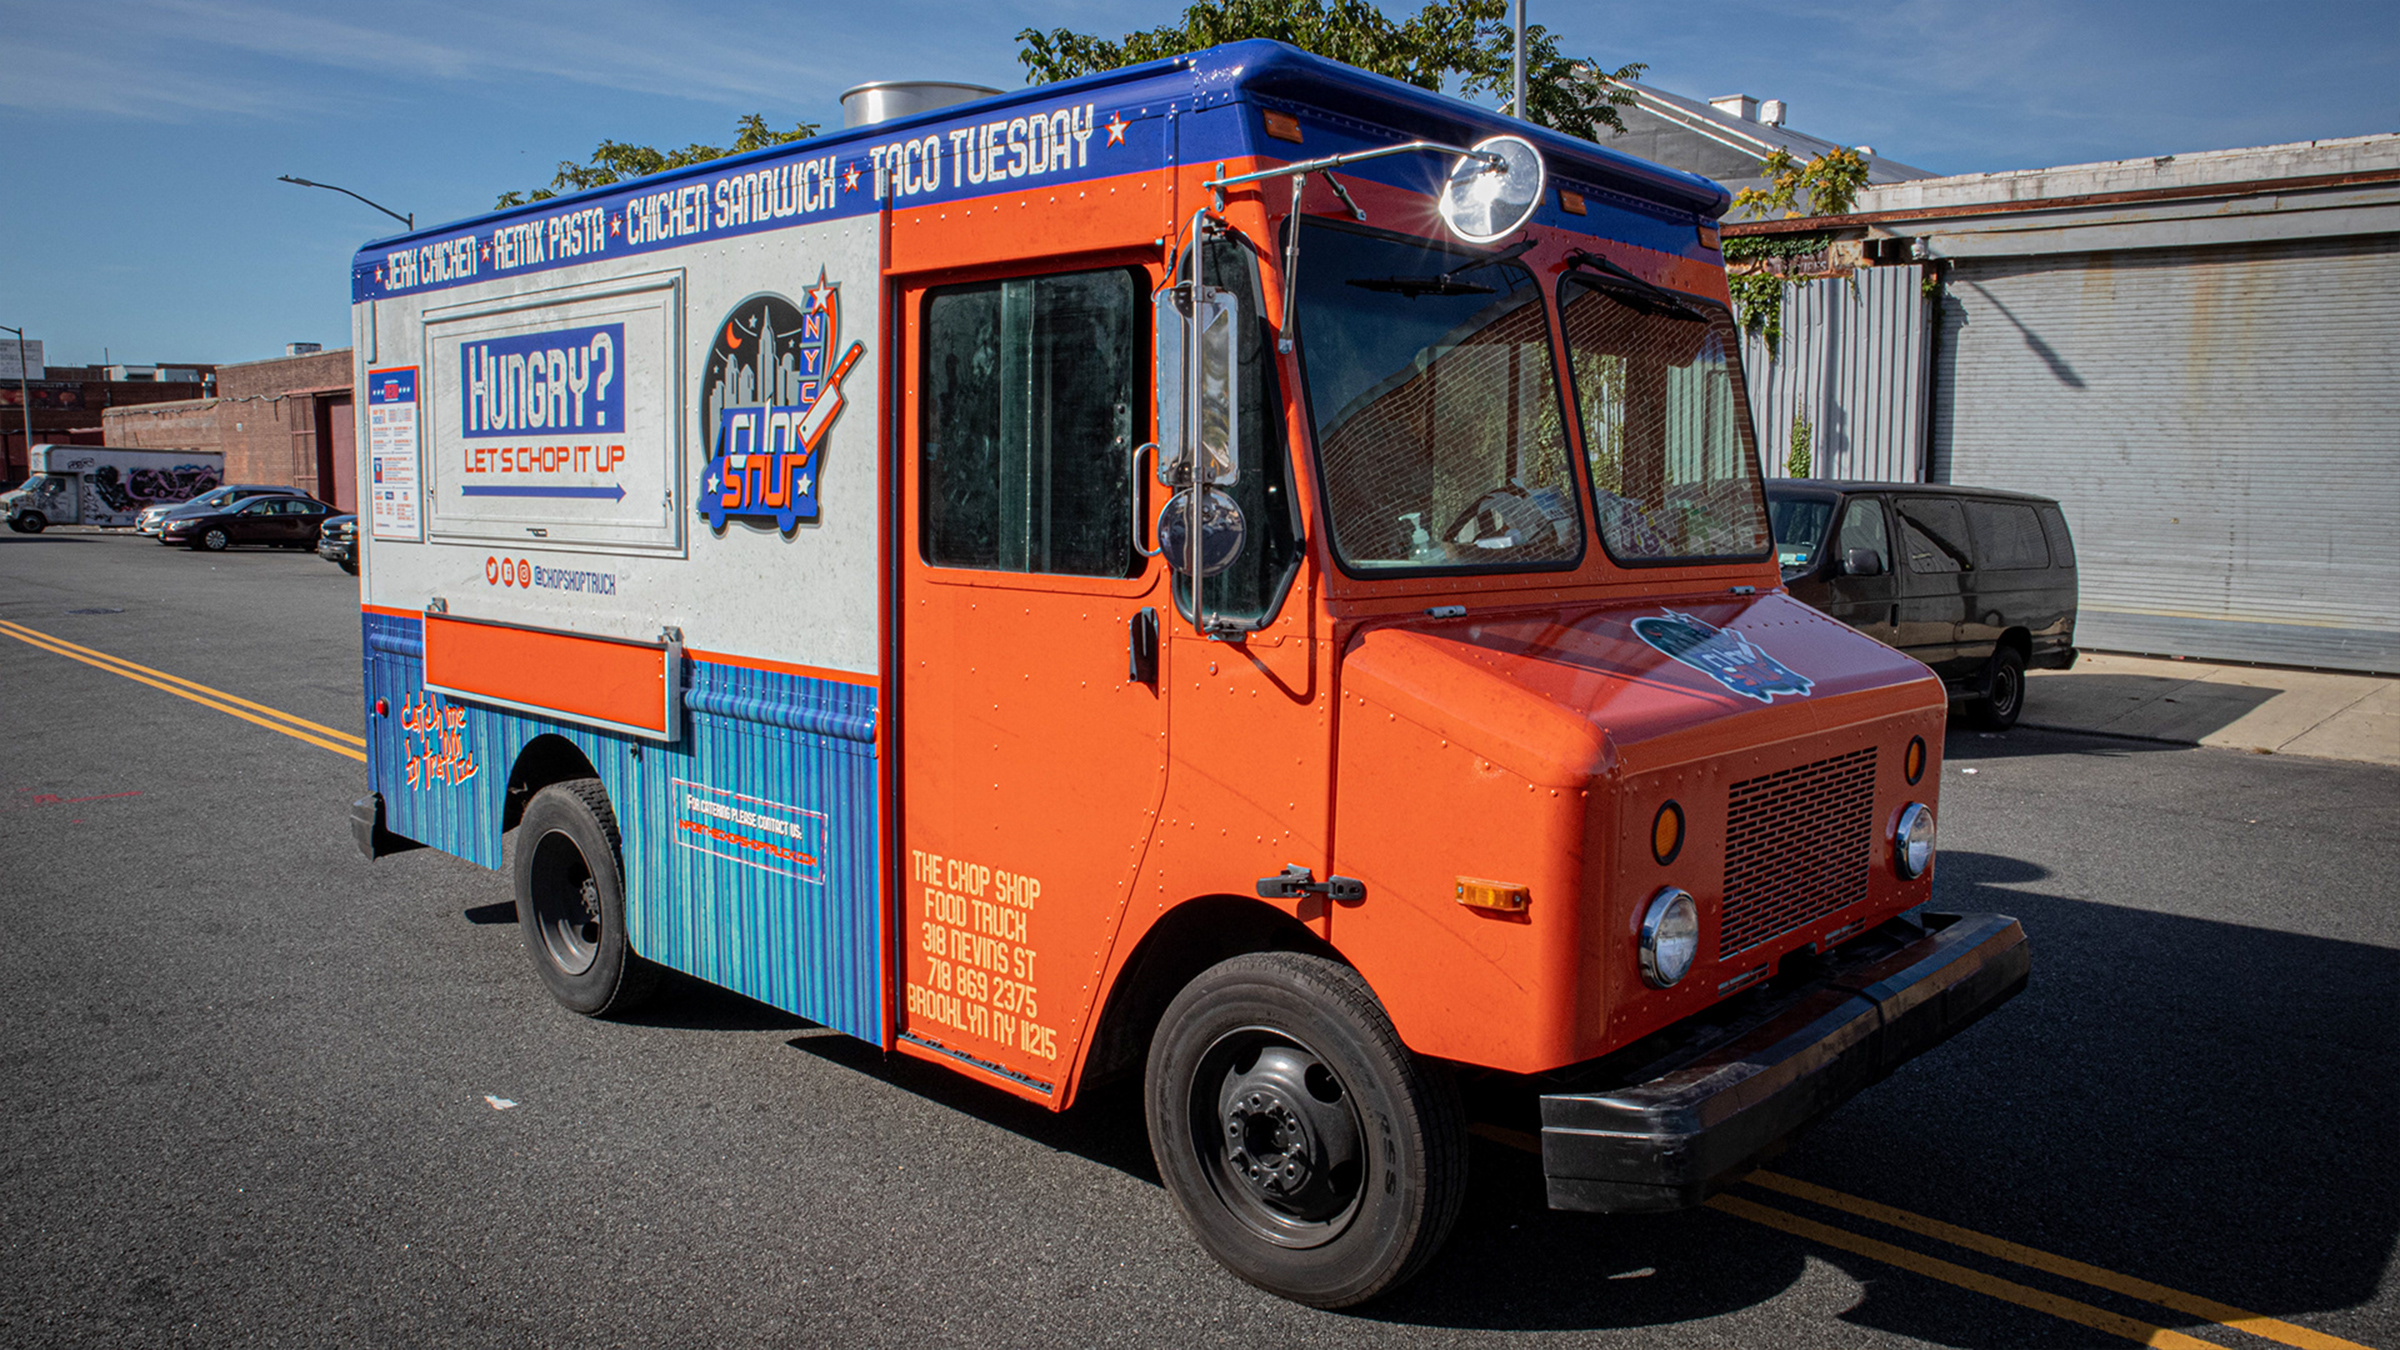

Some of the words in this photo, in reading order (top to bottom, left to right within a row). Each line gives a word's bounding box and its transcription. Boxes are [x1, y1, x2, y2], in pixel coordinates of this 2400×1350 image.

[869, 134, 941, 201] TACO
[949, 103, 1094, 188] TUESDAY
[626, 183, 710, 246] CHICKEN
[714, 155, 837, 229] SANDWICH
[384, 248, 418, 291] JERK
[420, 235, 479, 284] CHICKEN
[494, 219, 546, 271] REMIX
[549, 206, 606, 261] PASTA
[801, 314, 820, 404] NYC
[516, 446, 571, 473] CHOP
[573, 446, 592, 473] IT
[595, 445, 626, 473] UP
[534, 564, 617, 597] @CHOPSHOPTRUCK
[731, 807, 757, 828] PLEASE
[757, 815, 789, 836] CONTACT
[912, 849, 943, 887] THE
[947, 859, 990, 898] CHOP
[995, 870, 1041, 911] SHOP
[924, 887, 967, 928] FOOD
[971, 899, 1027, 944] TRUCK
[921, 921, 946, 956] 318
[951, 928, 1009, 974] NEVINS
[1014, 947, 1037, 982] ST
[927, 956, 951, 992] 718
[956, 965, 988, 1003] 869
[992, 976, 1038, 1019] 2375
[907, 981, 989, 1039] BROOKLYN
[993, 1010, 1016, 1046] NY
[1020, 1019, 1057, 1061] 11215
